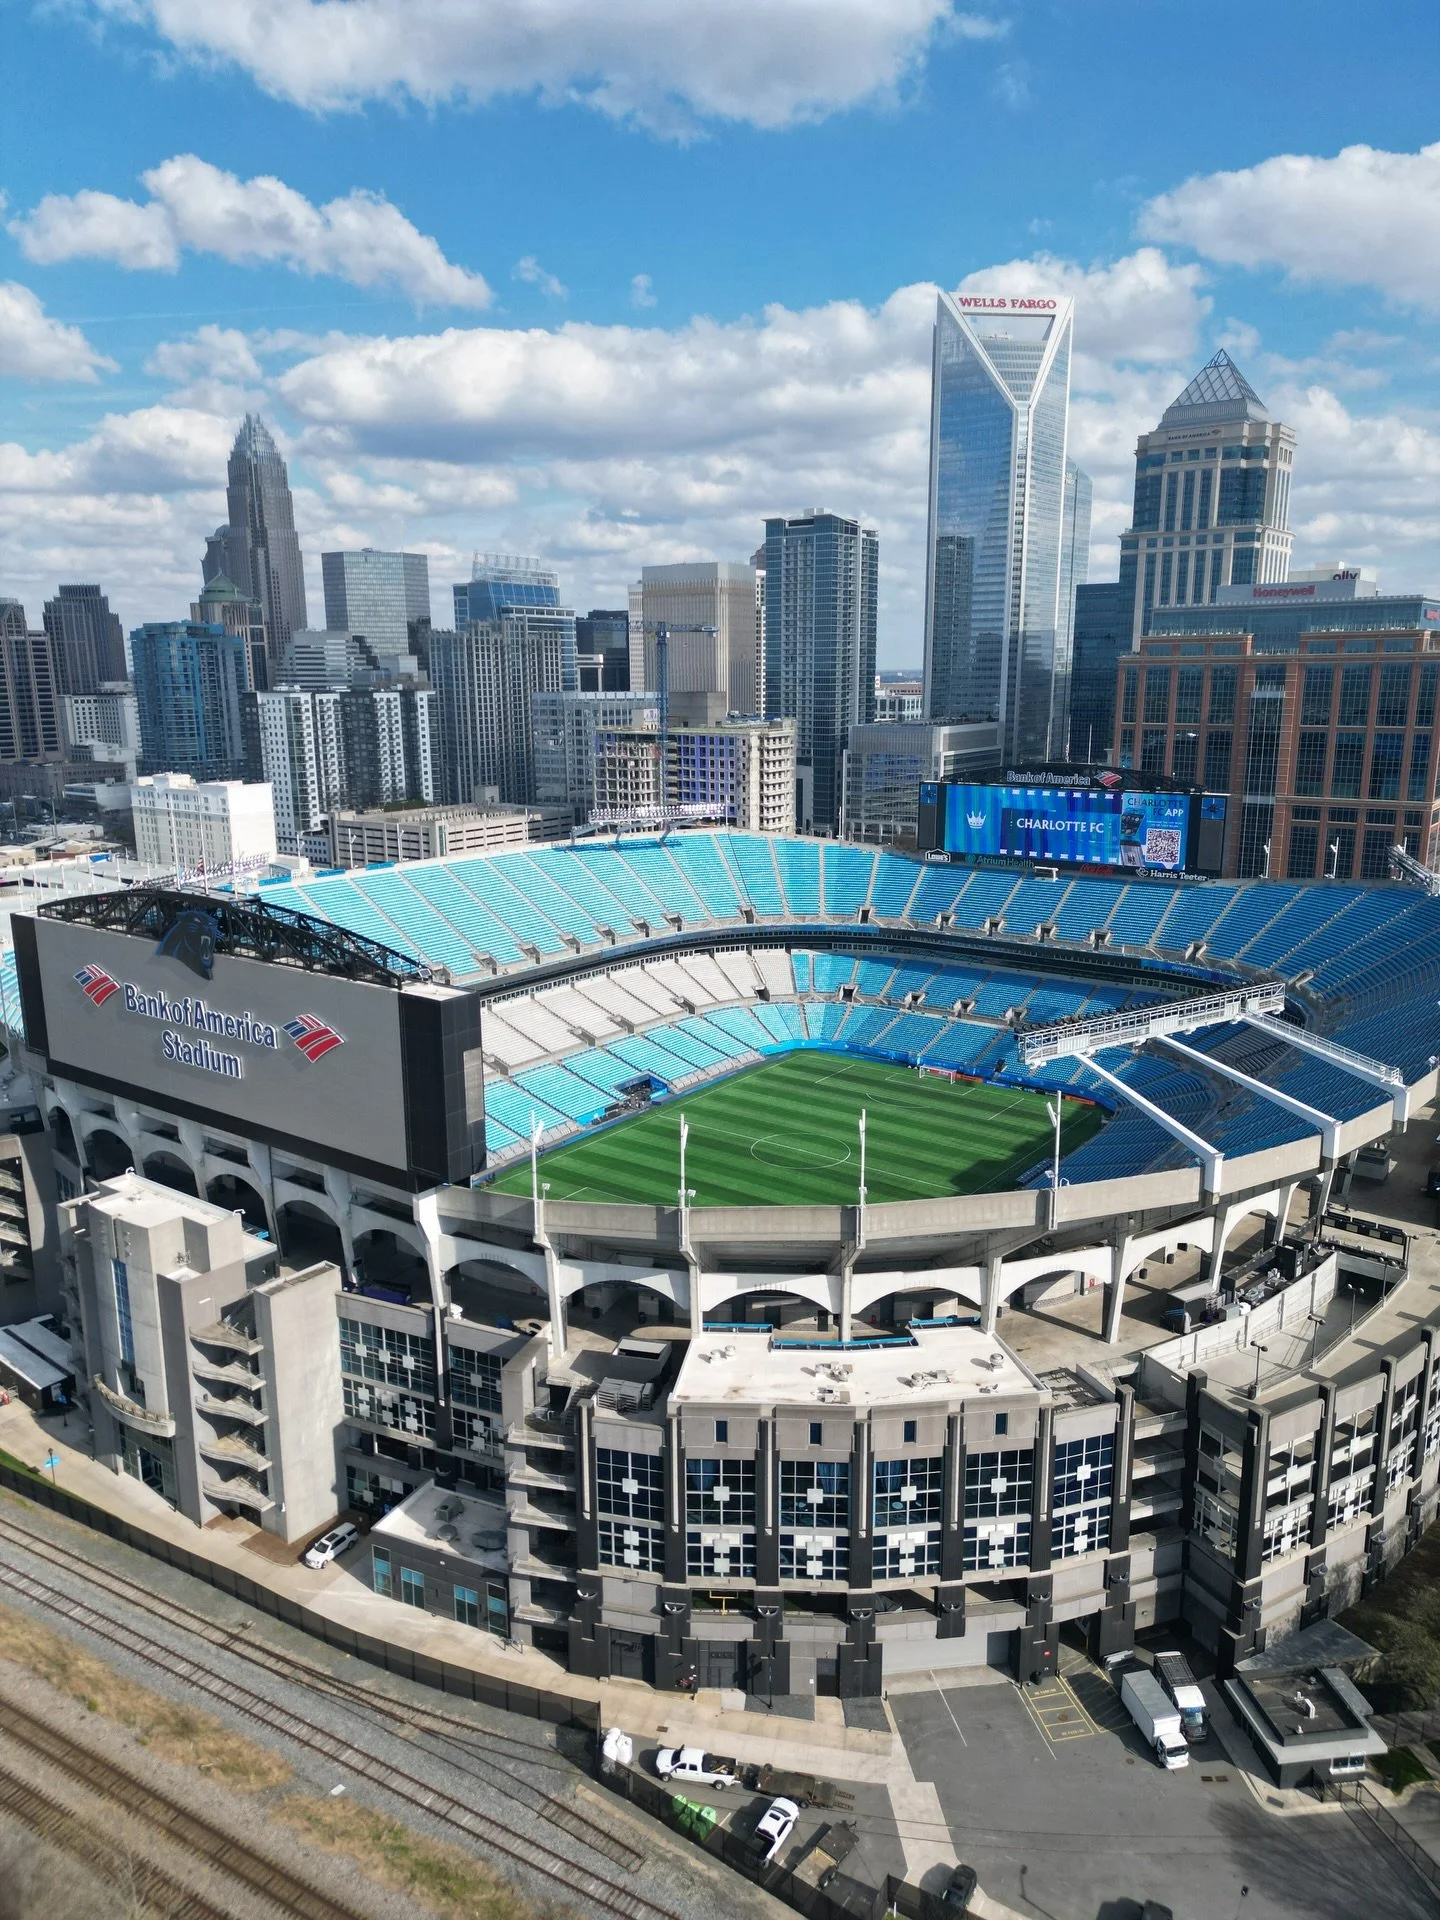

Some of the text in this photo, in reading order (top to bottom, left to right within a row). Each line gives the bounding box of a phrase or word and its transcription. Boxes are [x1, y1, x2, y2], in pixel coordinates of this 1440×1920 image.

[959, 297, 1057, 309] WELLS FARGO
[1253, 585, 1316, 598] Honeywell
[1127, 797, 1184, 809] CHARLOTTE
[1153, 807, 1184, 817] FC APP
[1016, 817, 1105, 834] CHARLOTTE FC
[976, 855, 1035, 868] Atrium Health
[1150, 869, 1208, 881] Harris Teeter
[161, 1030, 242, 1079] Stadium
